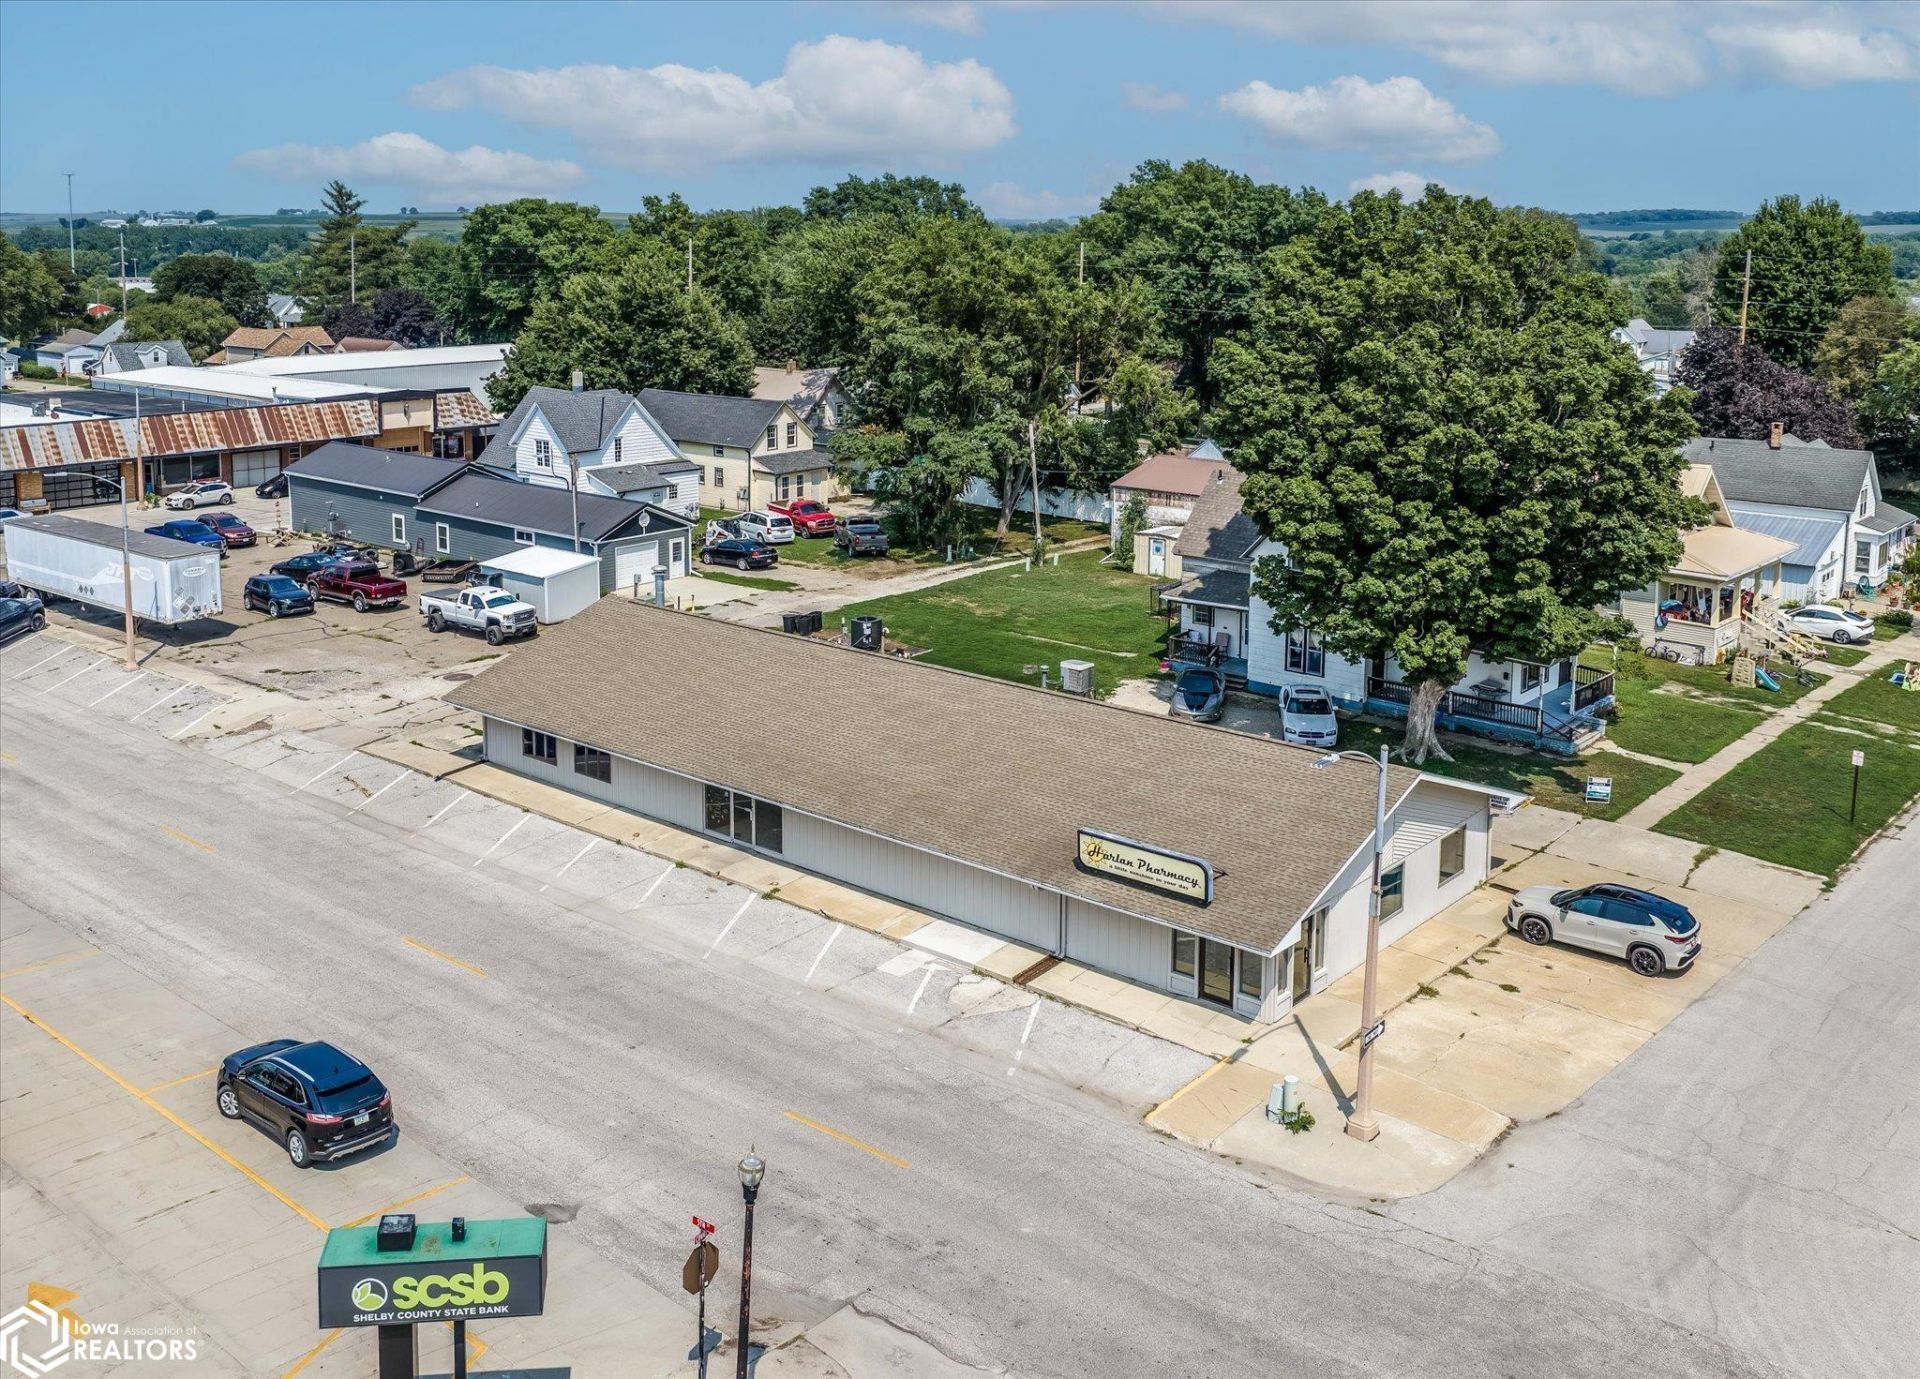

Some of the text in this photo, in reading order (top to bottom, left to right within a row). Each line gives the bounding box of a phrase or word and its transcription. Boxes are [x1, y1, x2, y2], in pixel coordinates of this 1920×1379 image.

[1088, 845, 1199, 888] Harlan Pharmacy
[392, 1263, 510, 1309] scsb
[353, 1305, 509, 1322] SHELBY COUNTY STATE BANK
